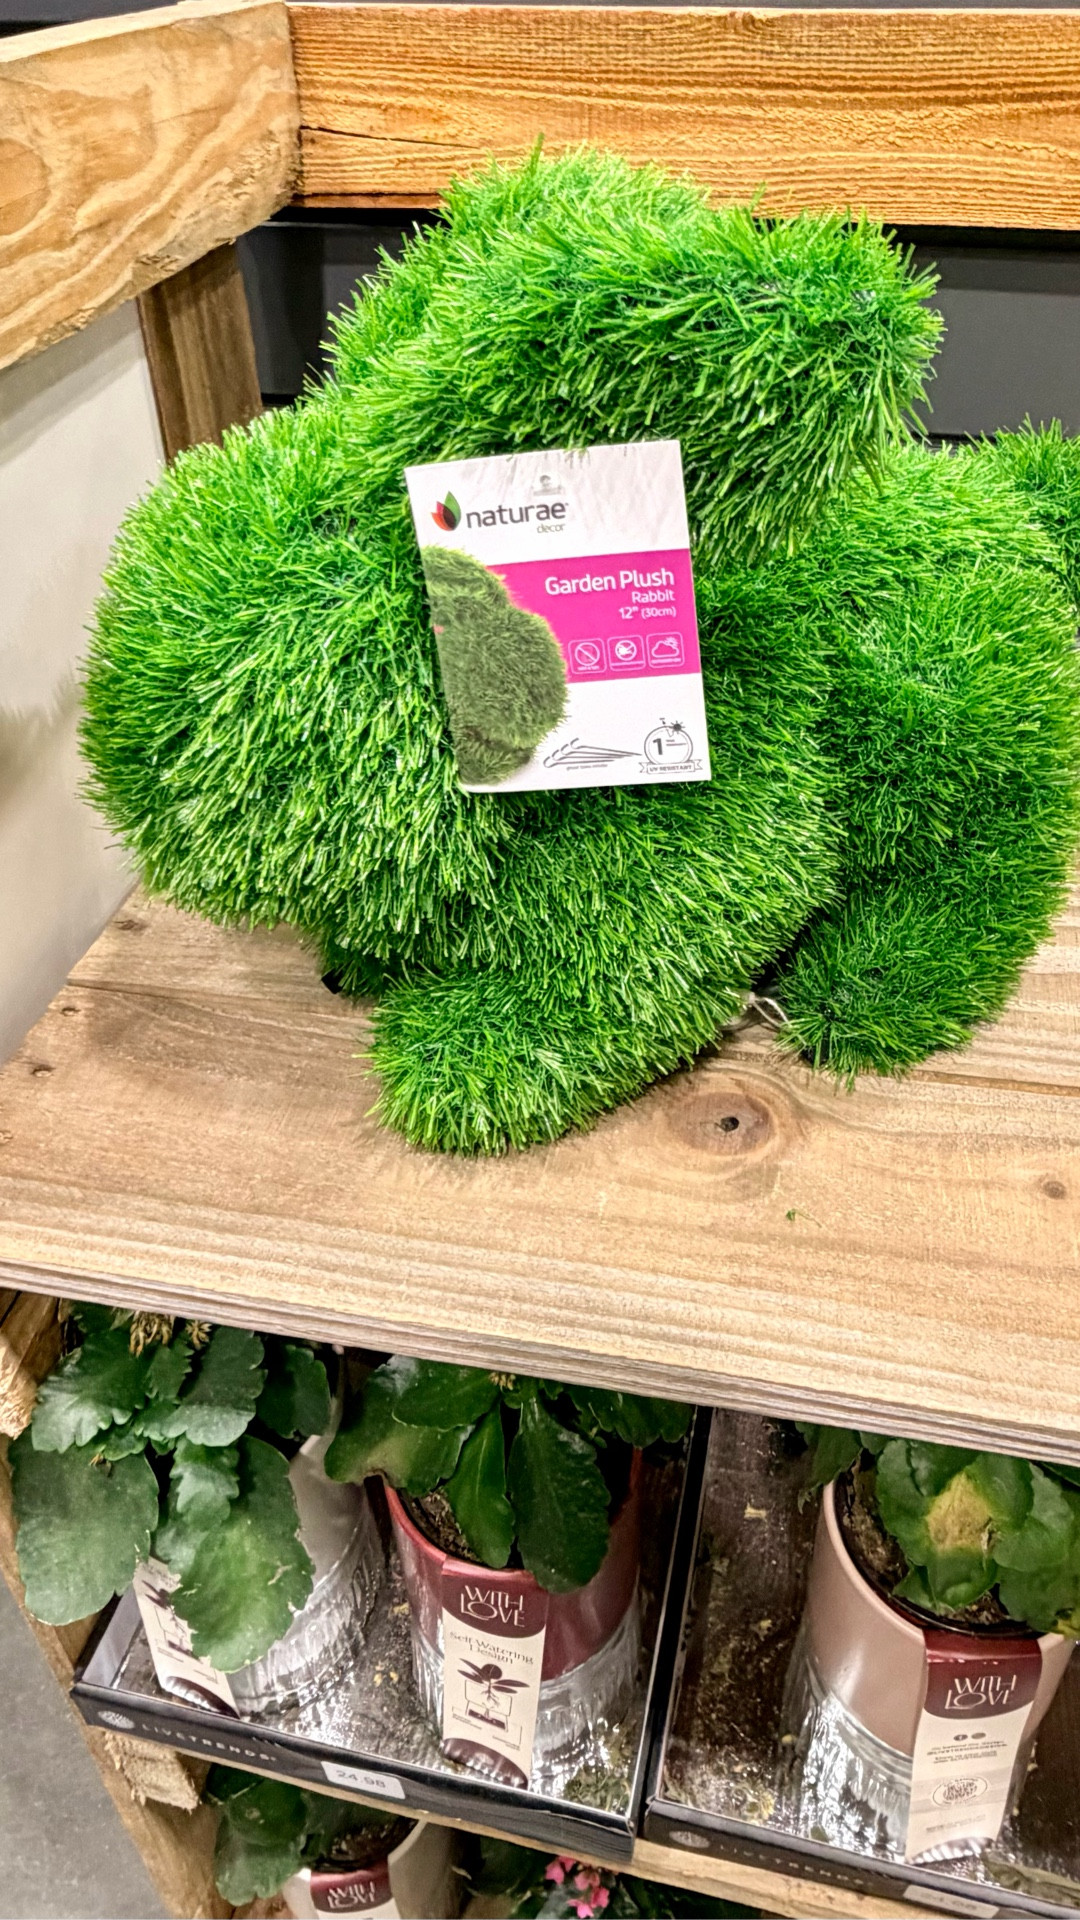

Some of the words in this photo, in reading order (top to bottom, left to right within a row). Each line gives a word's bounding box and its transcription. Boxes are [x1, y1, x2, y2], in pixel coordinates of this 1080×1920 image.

[466, 501, 566, 529] naturae
[537, 522, 566, 534] decor
[545, 572, 616, 596] Garden
[620, 568, 675, 592] Plush
[632, 589, 676, 604] Rabbit
[619, 606, 639, 620] 12"
[641, 605, 677, 619] (30cm)
[652, 737, 664, 756] 1
[464, 1584, 524, 1612] WITH
[460, 1592, 526, 1628] LOVE
[469, 1643, 514, 1665] Design
[954, 1674, 1017, 1694] WITH
[141, 1722, 272, 1762] LIVETRENDS
[335, 1769, 387, 1789] 24.98
